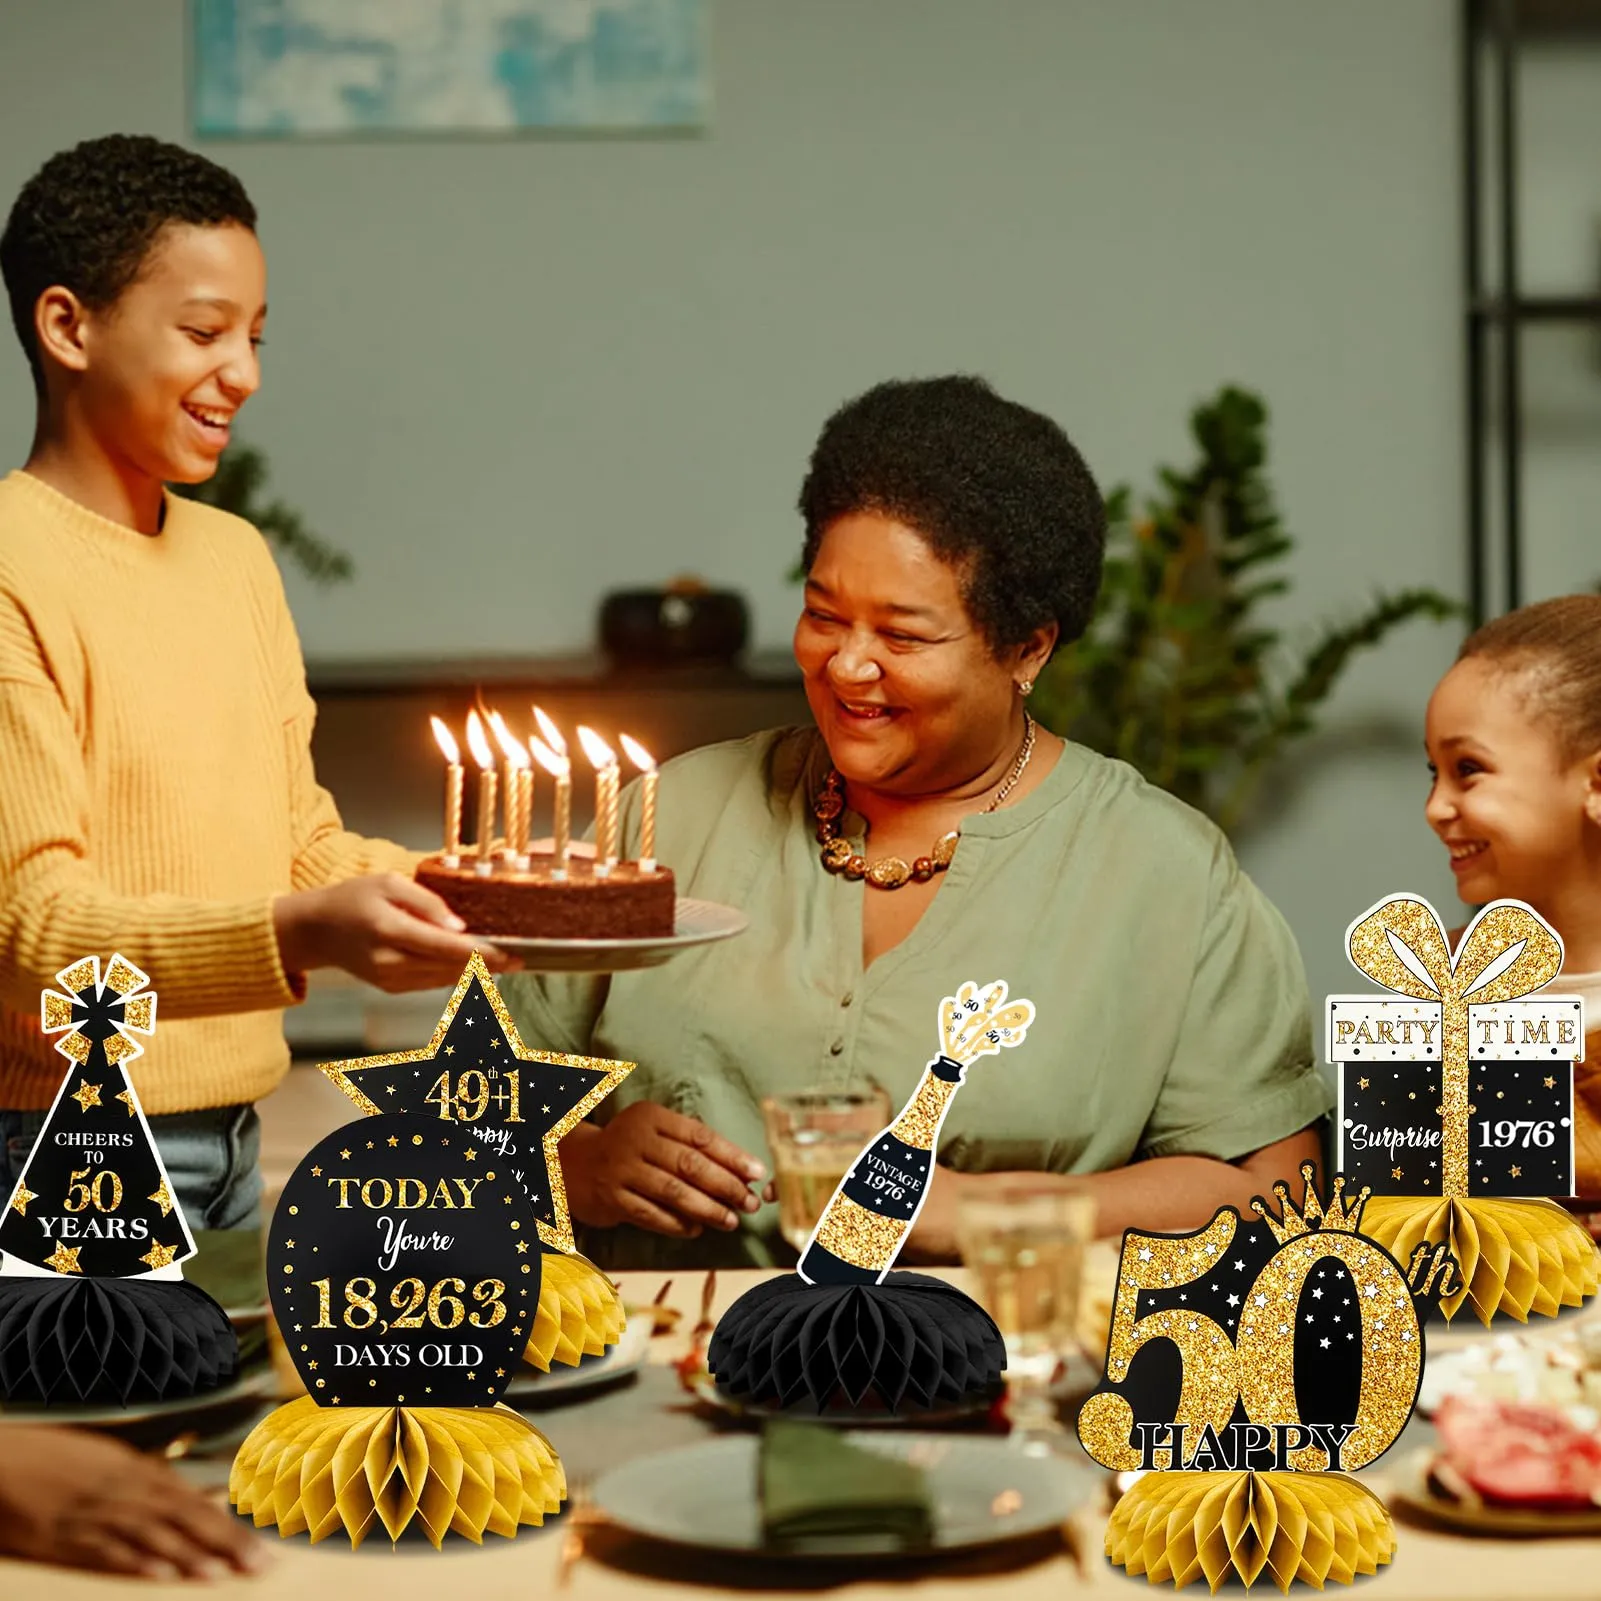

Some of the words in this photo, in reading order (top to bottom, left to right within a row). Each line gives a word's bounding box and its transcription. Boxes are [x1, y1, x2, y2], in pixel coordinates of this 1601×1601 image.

[951, 1012, 962, 1020] 50
[963, 999, 979, 1012] 50
[946, 1025, 955, 1033] 50
[956, 1033, 967, 1043] 50
[986, 1029, 1000, 1044] 50
[1336, 1020, 1440, 1044] PARTY
[1477, 1020, 1577, 1044] TIME
[54, 1132, 134, 1147] CHEERS
[1349, 1123, 1443, 1162] Surprise
[1478, 1119, 1556, 1148] 1976
[83, 1151, 104, 1165] TO
[866, 1153, 922, 1192] VINTAGE
[63, 1166, 124, 1213] 50
[327, 1178, 484, 1209] TODAY
[863, 1170, 906, 1201] 1976
[37, 1216, 149, 1240] YEARS
[311, 1276, 508, 1335] 18,263
[334, 1344, 411, 1367] DAYS
[418, 1344, 484, 1367] OLD
[1136, 1422, 1360, 1472] HAPPY
